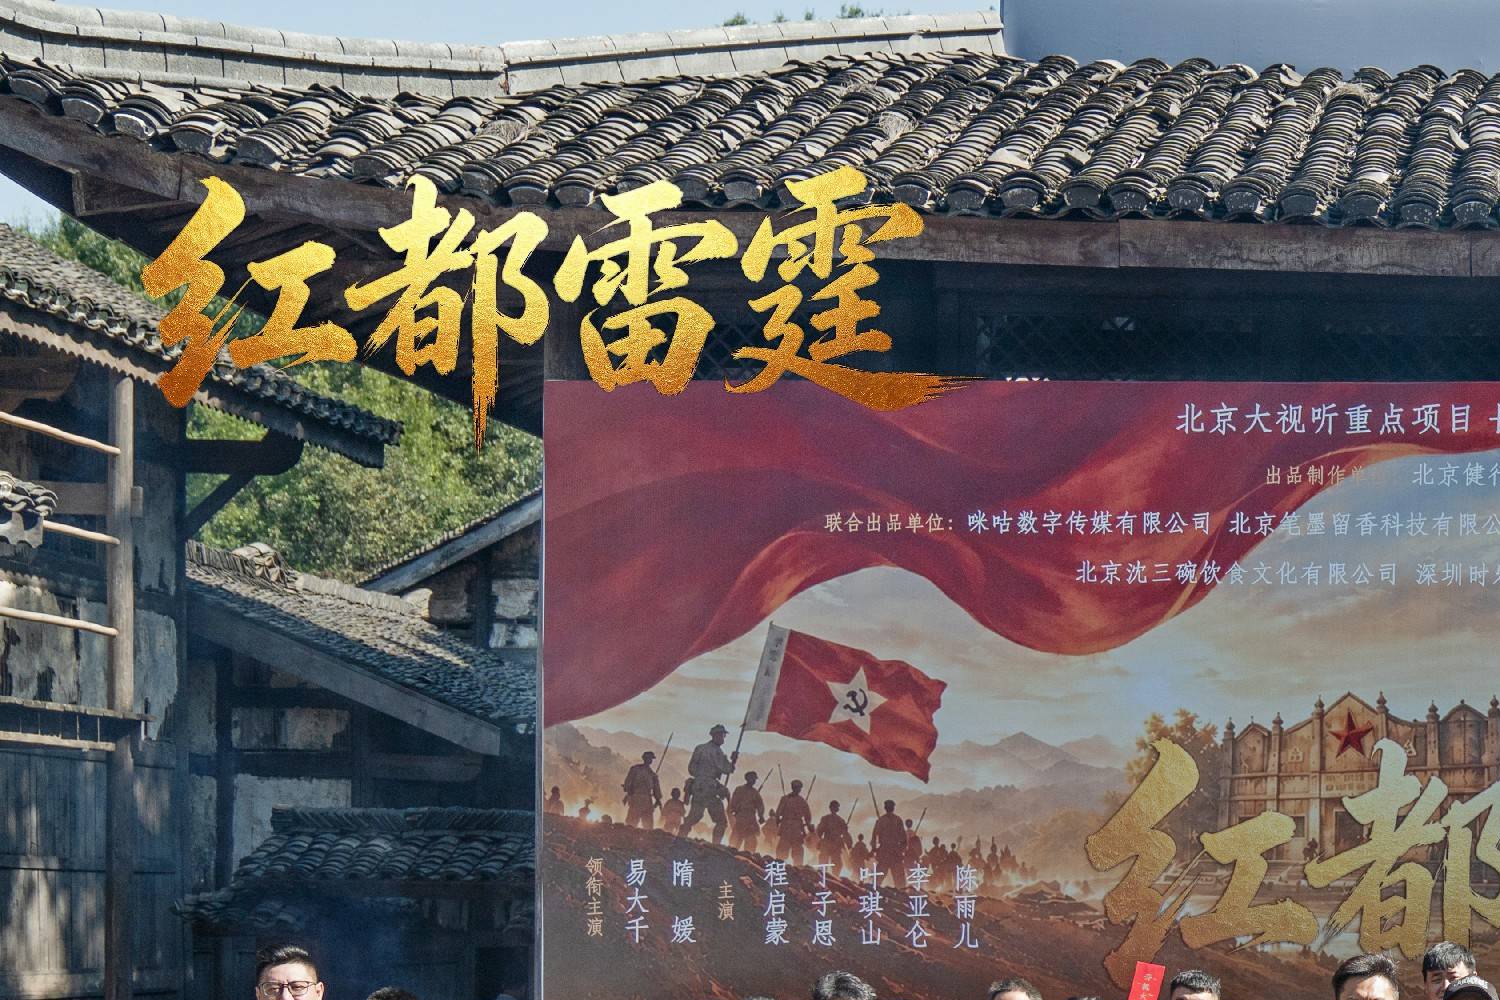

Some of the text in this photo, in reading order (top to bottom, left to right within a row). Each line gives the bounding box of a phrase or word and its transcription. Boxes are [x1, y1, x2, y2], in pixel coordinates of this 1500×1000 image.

[1176, 402, 1471, 436] 北京大视听重点项目
[967, 510, 1211, 535] 咪咕数字传媒有限公司
[1075, 559, 1397, 586] 北京沈三碗饮食文化有限公司
[585, 856, 604, 937] 领衔主演
[625, 858, 649, 944] 易大千
[718, 879, 735, 921] 主演
[764, 860, 789, 946] 程启蒙
[811, 863, 836, 947] 丁子恩
[858, 862, 885, 946] 叶琪山
[905, 863, 932, 949] 李亚仑
[953, 864, 979, 949] 陈雨儿
